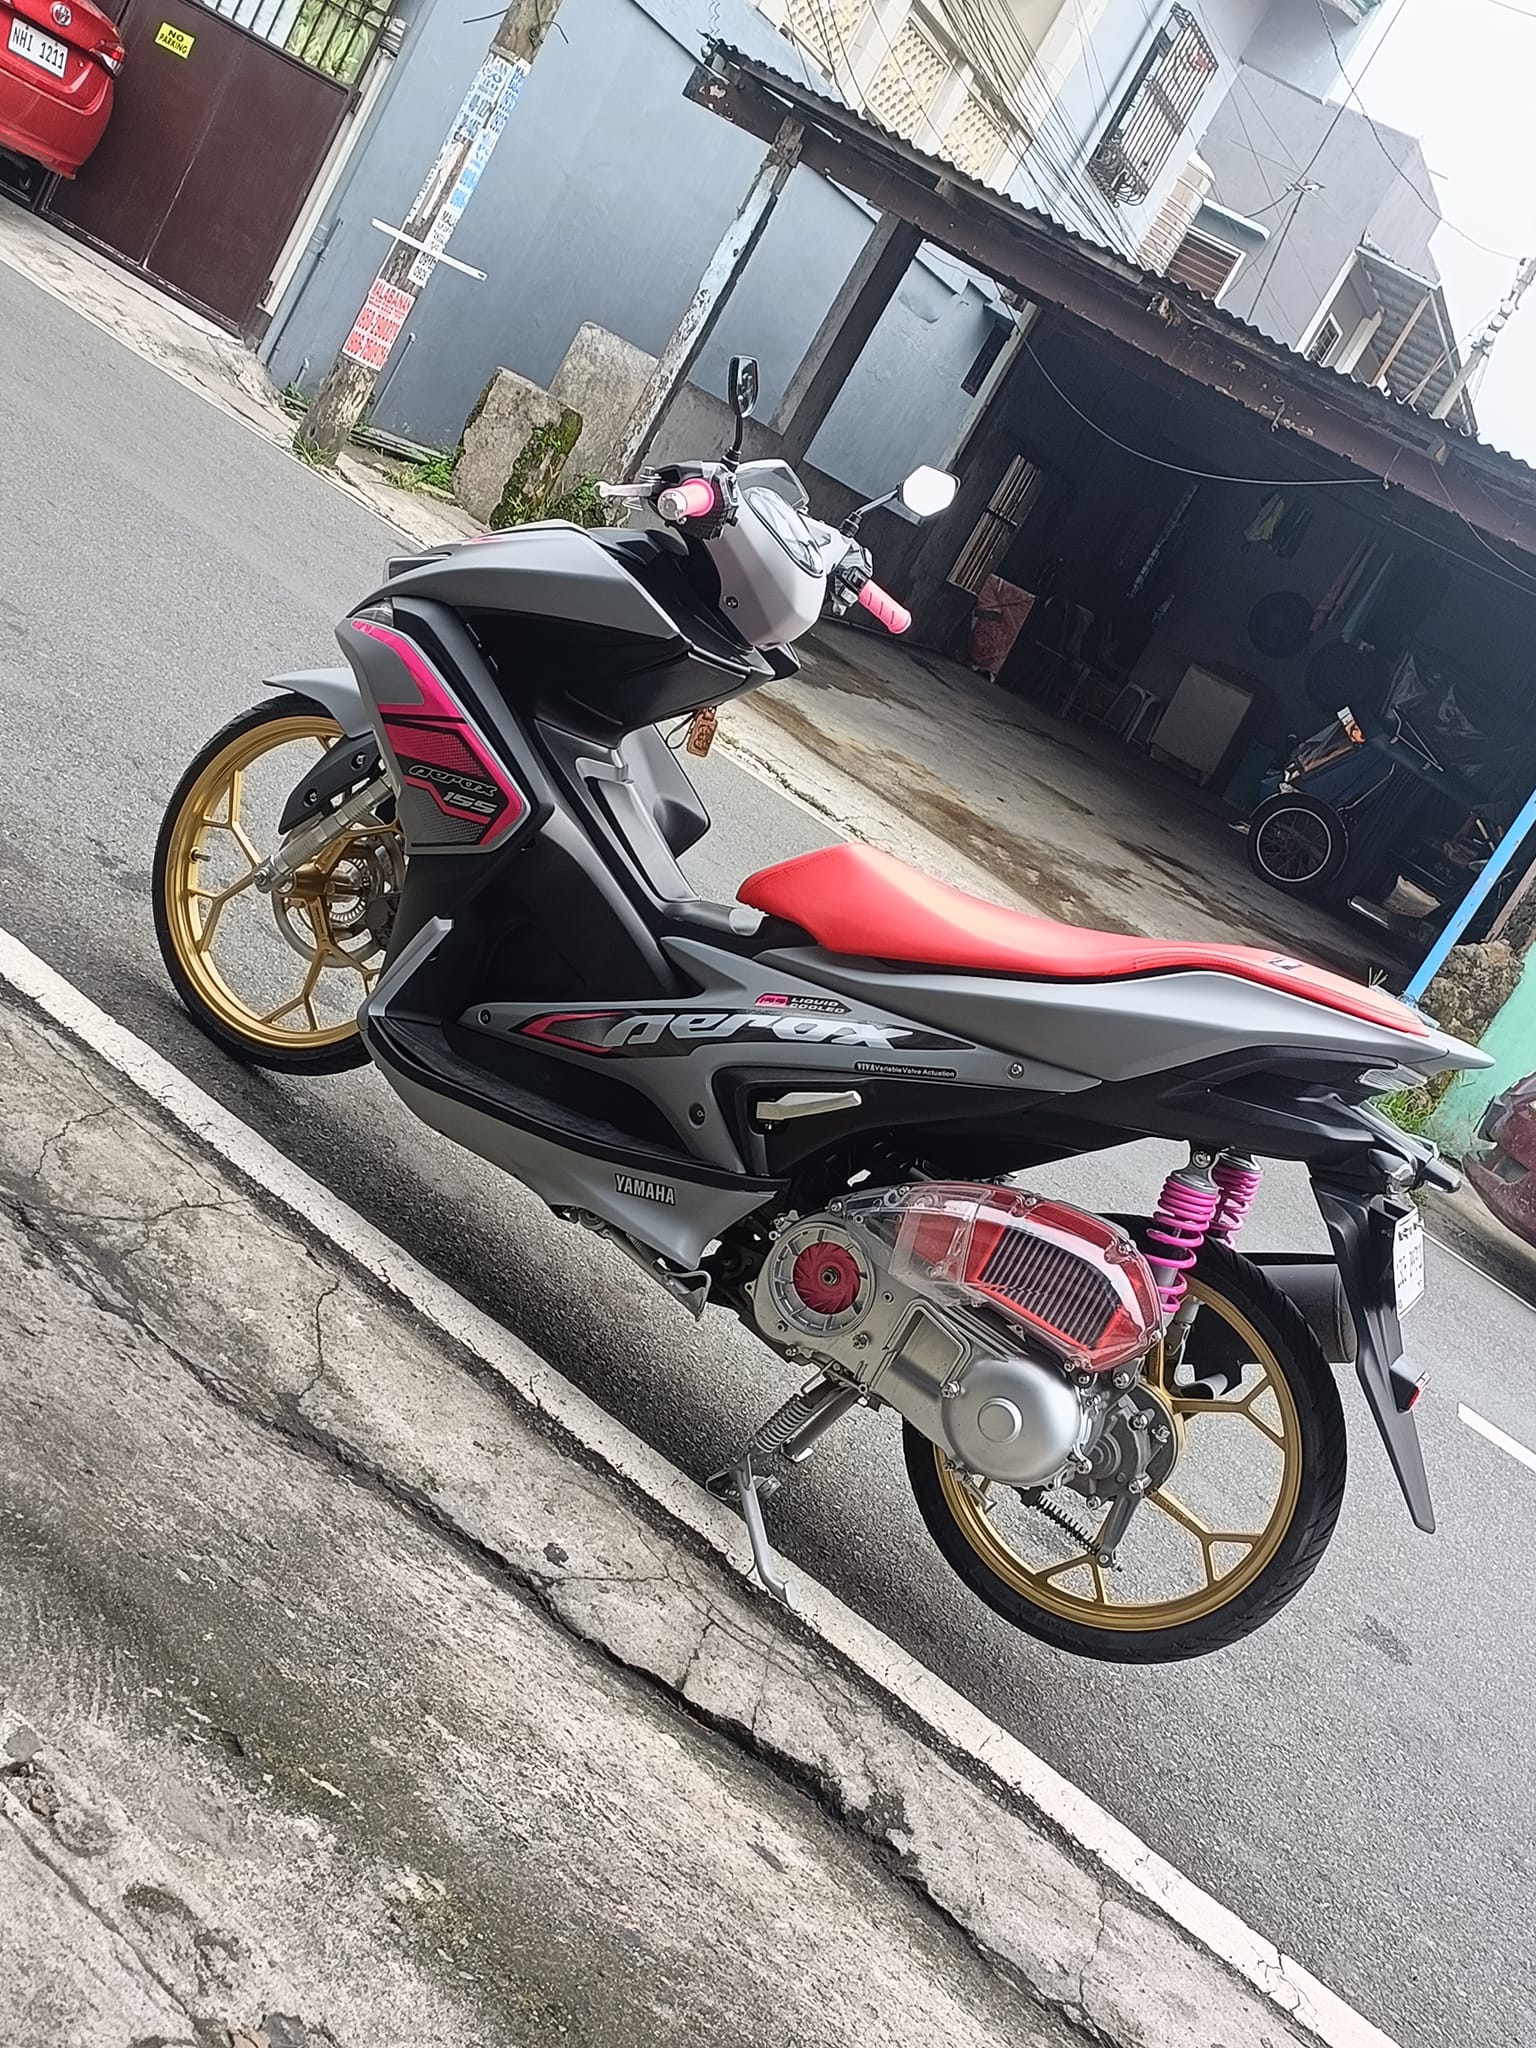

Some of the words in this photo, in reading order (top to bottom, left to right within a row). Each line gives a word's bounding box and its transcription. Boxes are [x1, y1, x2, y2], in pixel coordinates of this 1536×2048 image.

[159, 33, 188, 54] PARKING
[168, 29, 184, 42] NO
[12, 26, 33, 52] NHI
[39, 42, 64, 69] 1211
[443, 791, 498, 814] 155
[789, 1003, 845, 1014] COOLED
[791, 997, 839, 1007] LIQUID
[615, 1174, 675, 1205] YAMAHA
